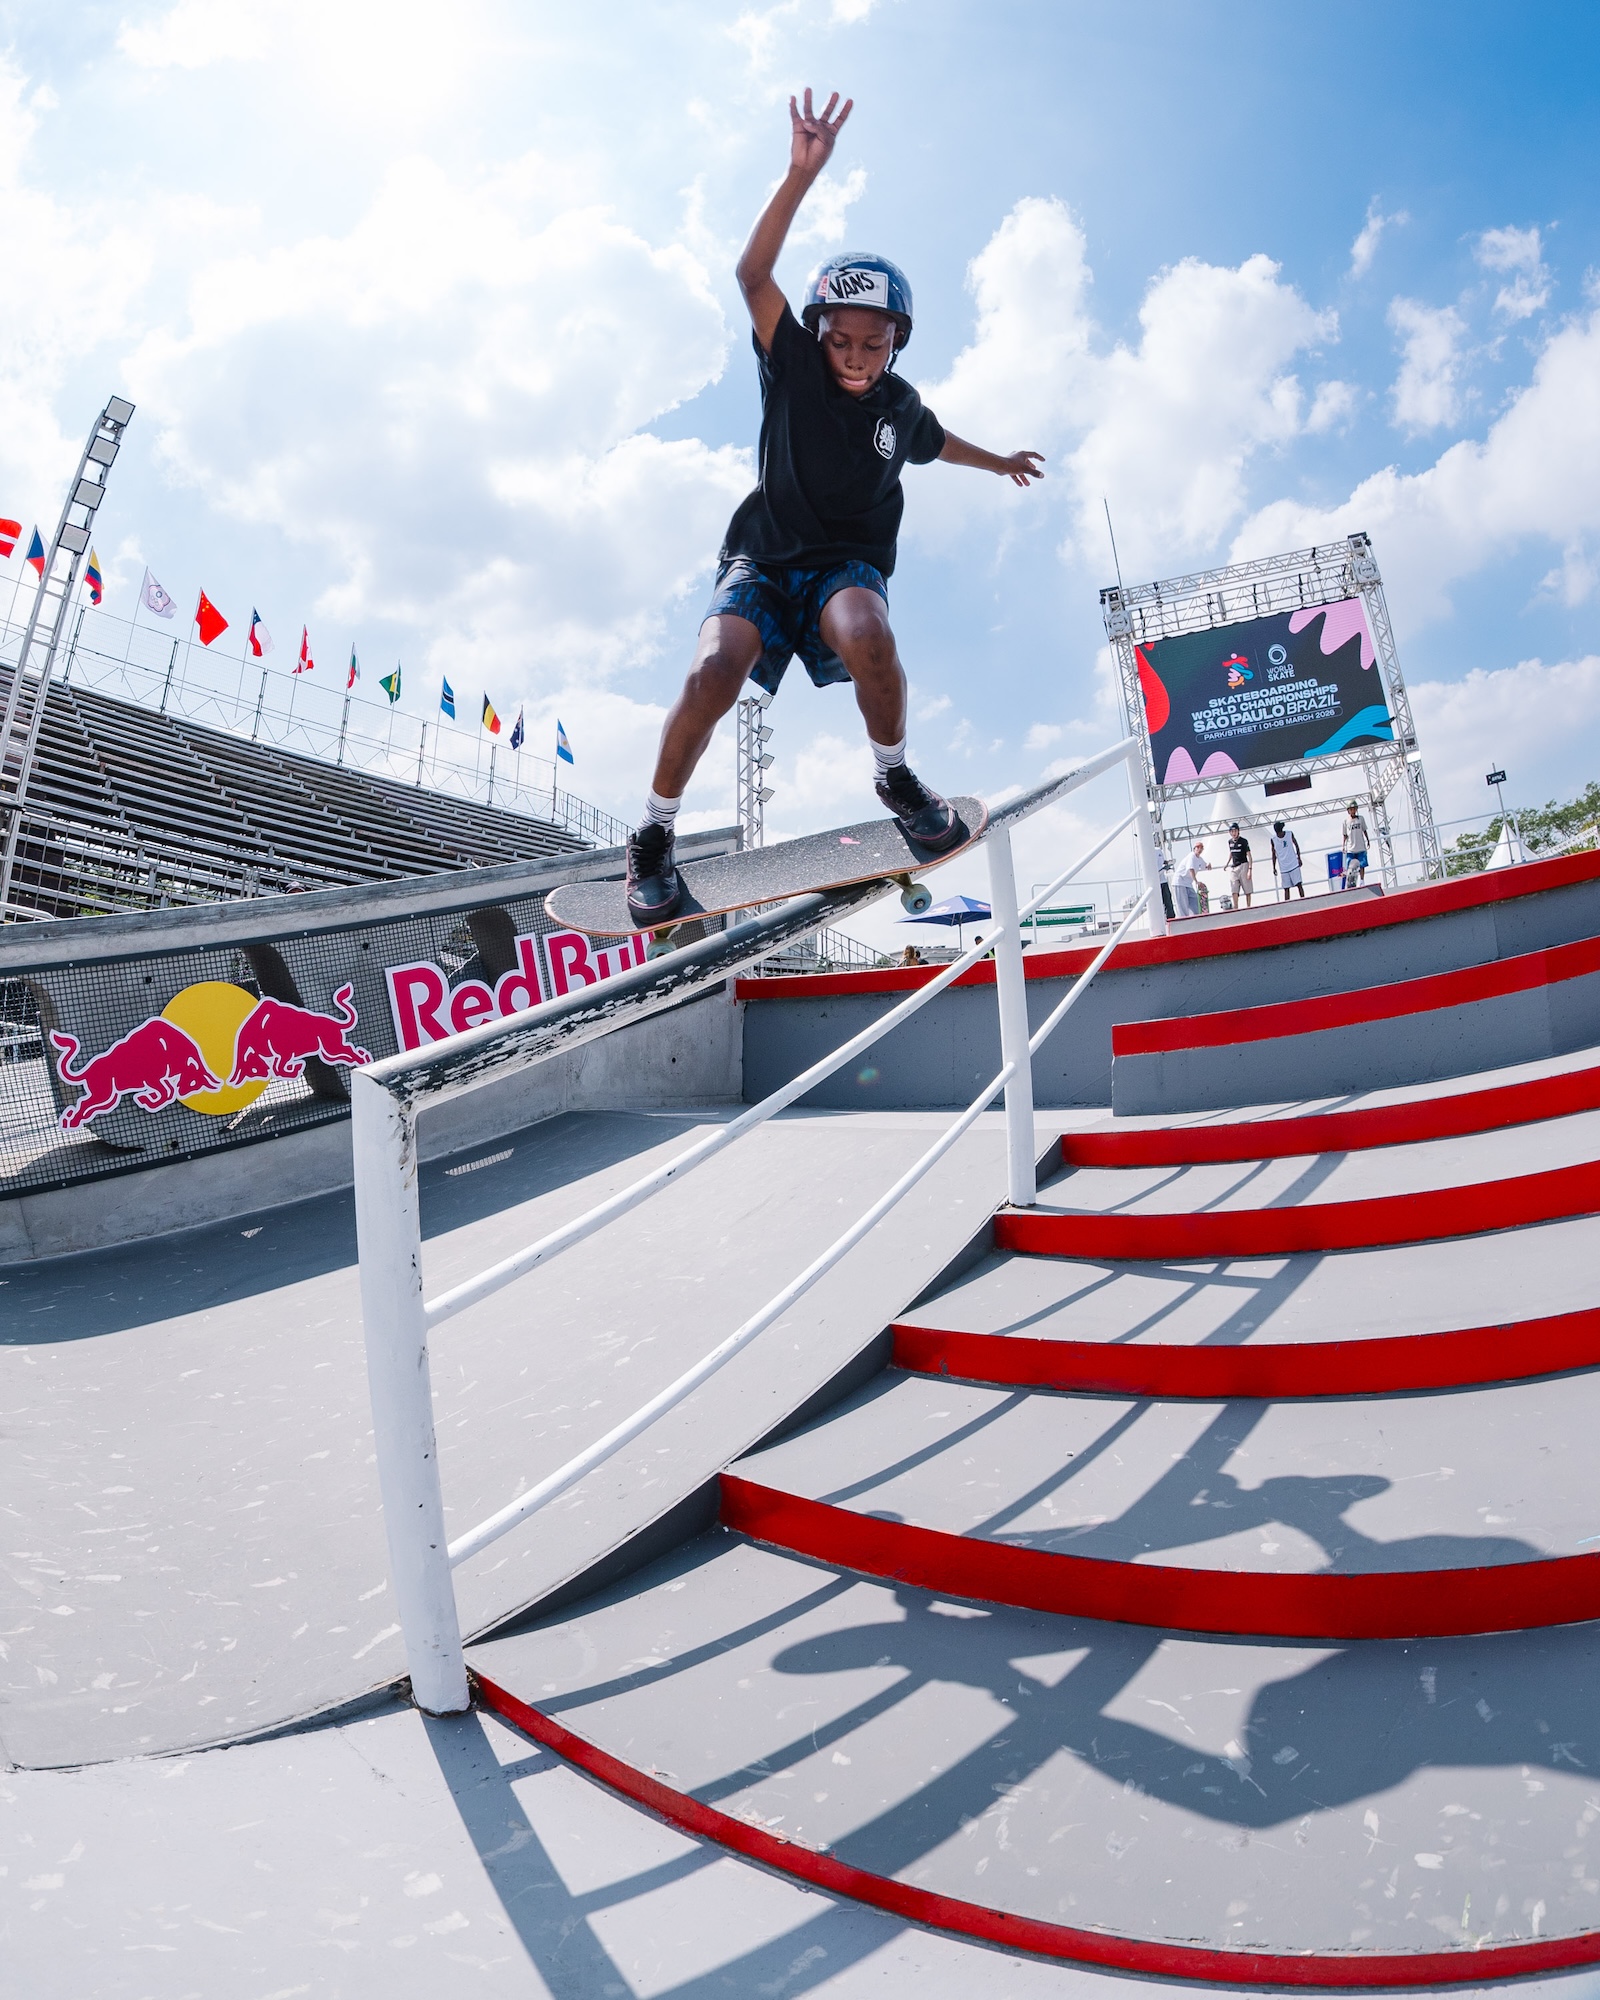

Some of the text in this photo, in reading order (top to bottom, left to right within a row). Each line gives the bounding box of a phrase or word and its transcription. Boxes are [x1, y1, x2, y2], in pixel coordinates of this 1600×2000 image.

[830, 271, 875, 299] VANS
[1266, 663, 1294, 674] WORLD
[1267, 669, 1296, 682] SKATE
[1191, 683, 1339, 721] WORLD CHAMPIONSHIPS
[1208, 678, 1319, 708] SKATEBOARDING
[1193, 693, 1341, 733] SÃO PAULO BRAZIL
[1203, 724, 1258, 741] PARK/STREET
[1263, 719, 1285, 730] 01-08
[1285, 714, 1315, 725] MARCH
[1315, 709, 1336, 720] 2026
[392, 938, 543, 1051] Red
